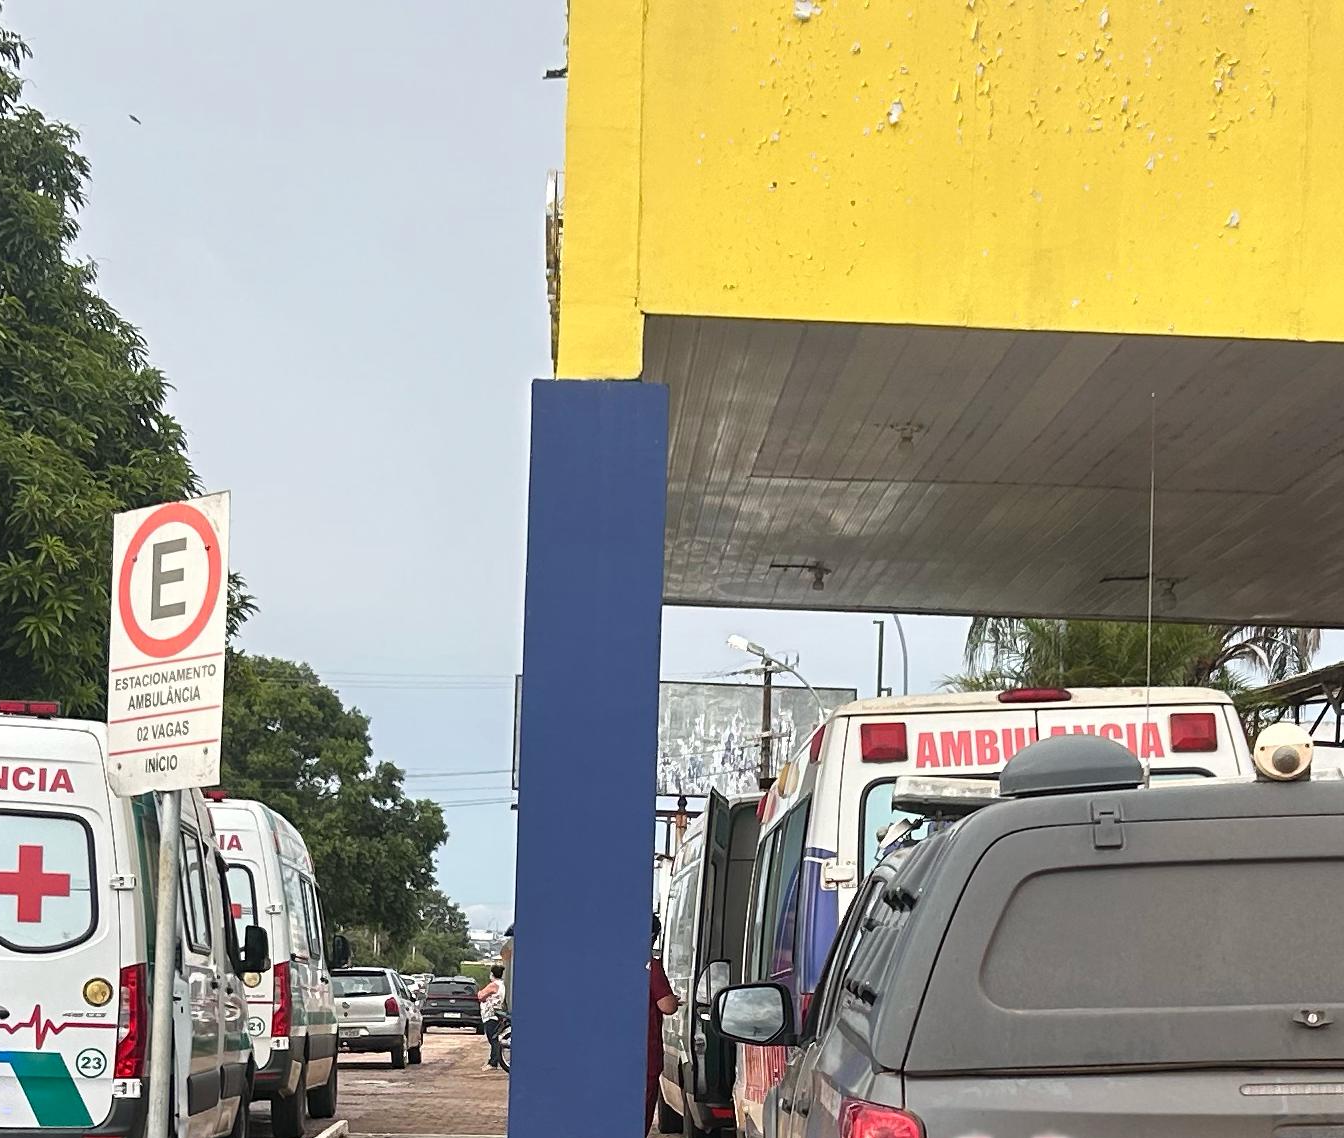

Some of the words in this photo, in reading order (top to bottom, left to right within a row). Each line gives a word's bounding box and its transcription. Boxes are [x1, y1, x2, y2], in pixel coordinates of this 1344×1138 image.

[150, 536, 188, 621] E
[114, 663, 216, 691] ESTACIONAMENTO
[127, 685, 201, 711] AMBULÂNCIA
[136, 726, 149, 742] 02
[151, 720, 190, 740] VAGAS
[145, 752, 178, 773] INÍCIO
[248, 1022, 262, 1031] 21
[81, 1056, 103, 1070] 23
